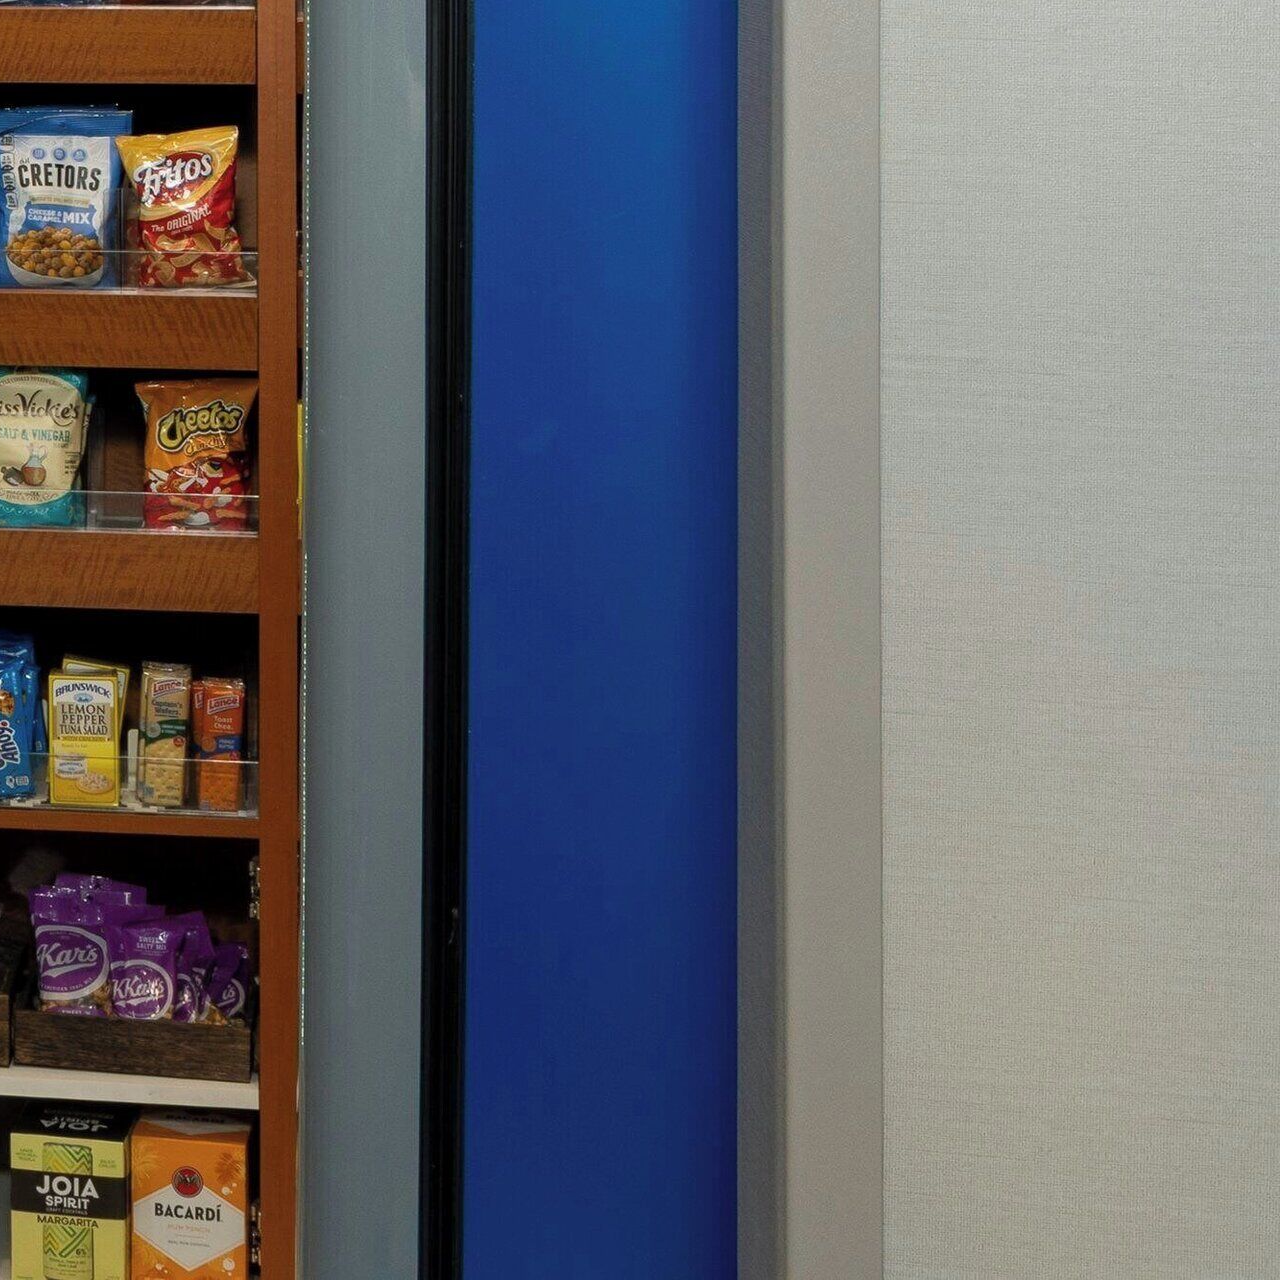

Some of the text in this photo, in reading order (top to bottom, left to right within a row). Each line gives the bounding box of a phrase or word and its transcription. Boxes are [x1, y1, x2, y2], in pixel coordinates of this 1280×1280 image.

[17, 163, 102, 192] CRETORS
[133, 154, 212, 207] Fritos
[63, 211, 90, 224] MIX
[151, 224, 165, 233] The
[15, 389, 79, 427] Vickie's
[159, 400, 243, 448] Cheetos
[21, 429, 29, 440] &
[31, 429, 71, 442] VINEGAR
[55, 682, 111, 699] BRUNSWICK
[61, 704, 106, 715] LEMON
[209, 696, 239, 710] Lance
[62, 714, 107, 725] PEPPER
[60, 724, 109, 736] TUNA SALAD
[36, 1175, 100, 1199] JOIA
[45, 1195, 90, 1210] SPIRIT
[154, 1202, 222, 1222] BACARDÍ
[37, 1215, 99, 1228] MARGARITA
